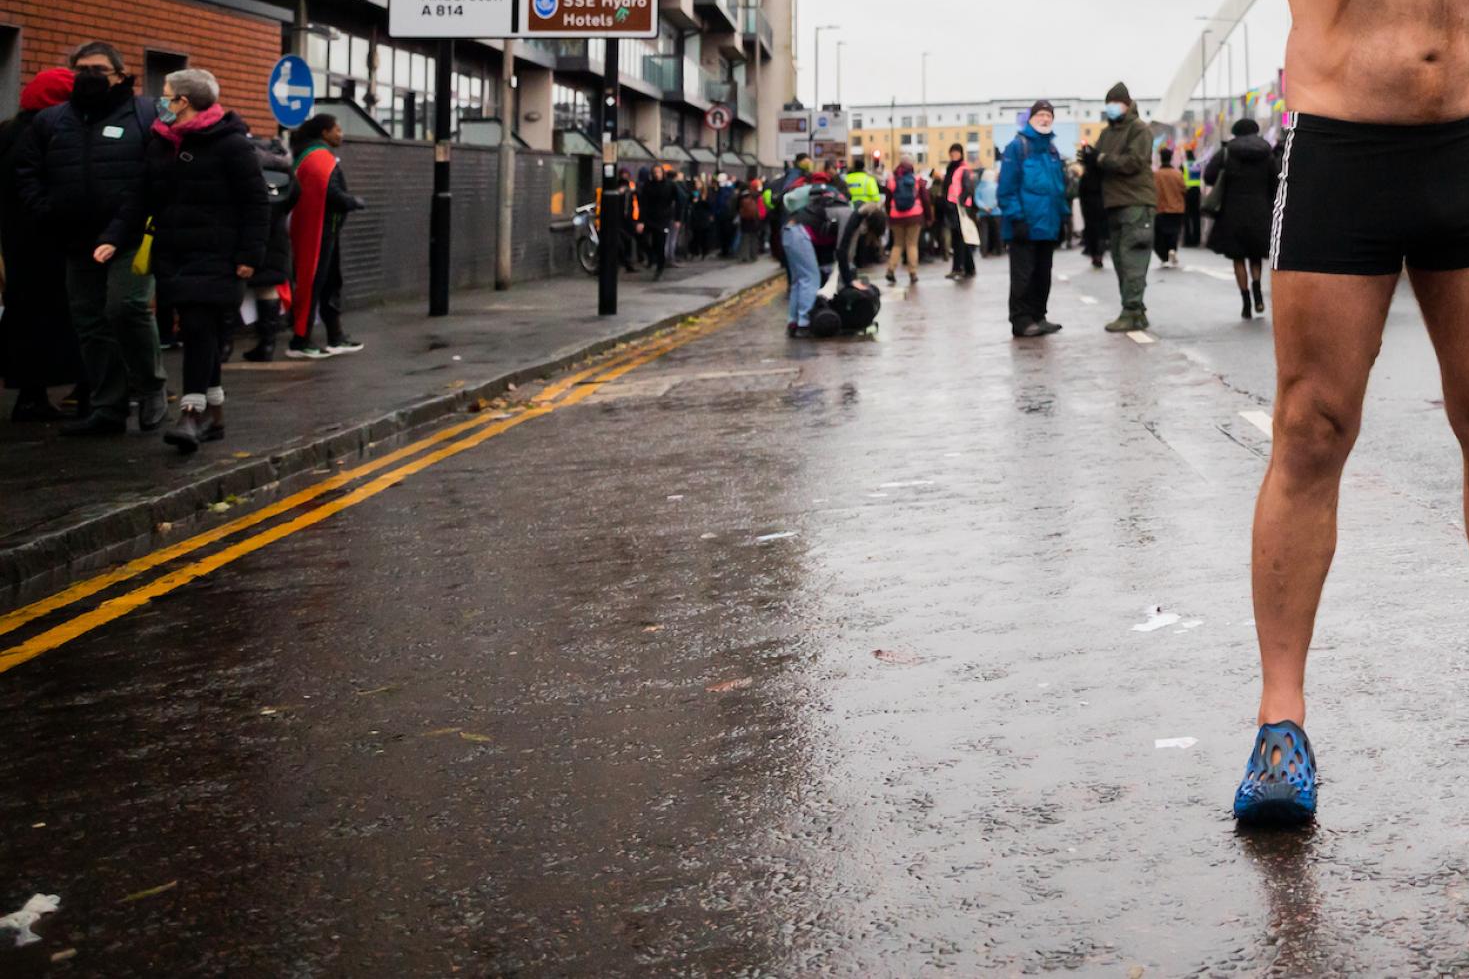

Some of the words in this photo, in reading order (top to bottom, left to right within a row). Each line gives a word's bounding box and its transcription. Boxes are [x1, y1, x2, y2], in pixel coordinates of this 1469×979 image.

[422, 5, 432, 17] A
[435, 5, 464, 17] 814
[563, 12, 613, 27] Hotels
